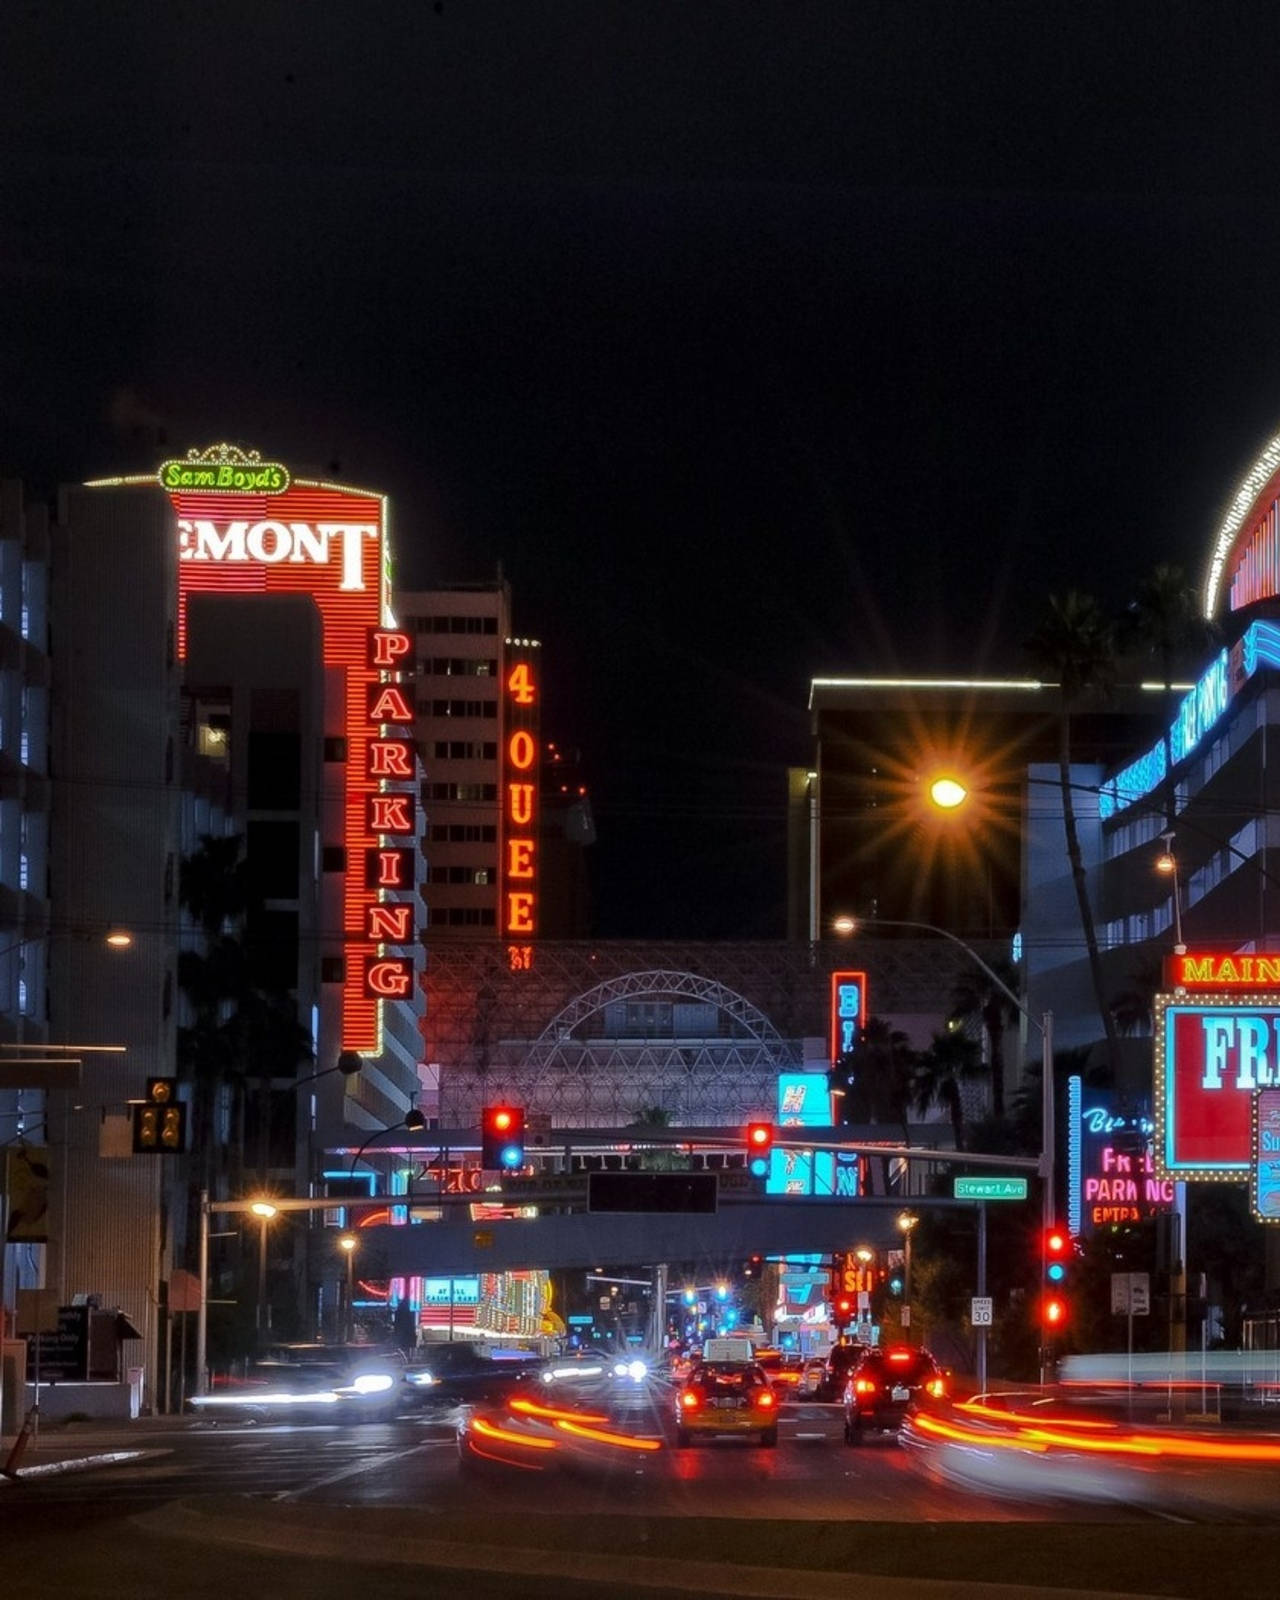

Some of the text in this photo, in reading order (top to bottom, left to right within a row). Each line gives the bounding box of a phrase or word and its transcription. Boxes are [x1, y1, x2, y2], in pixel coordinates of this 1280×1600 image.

[508, 664, 535, 703] 4
[369, 633, 413, 995] PARKING
[958, 1183, 1024, 1194] Stewart Ave
[1086, 1179, 1175, 1202] PARKNG
[975, 1311, 990, 1322] 30
